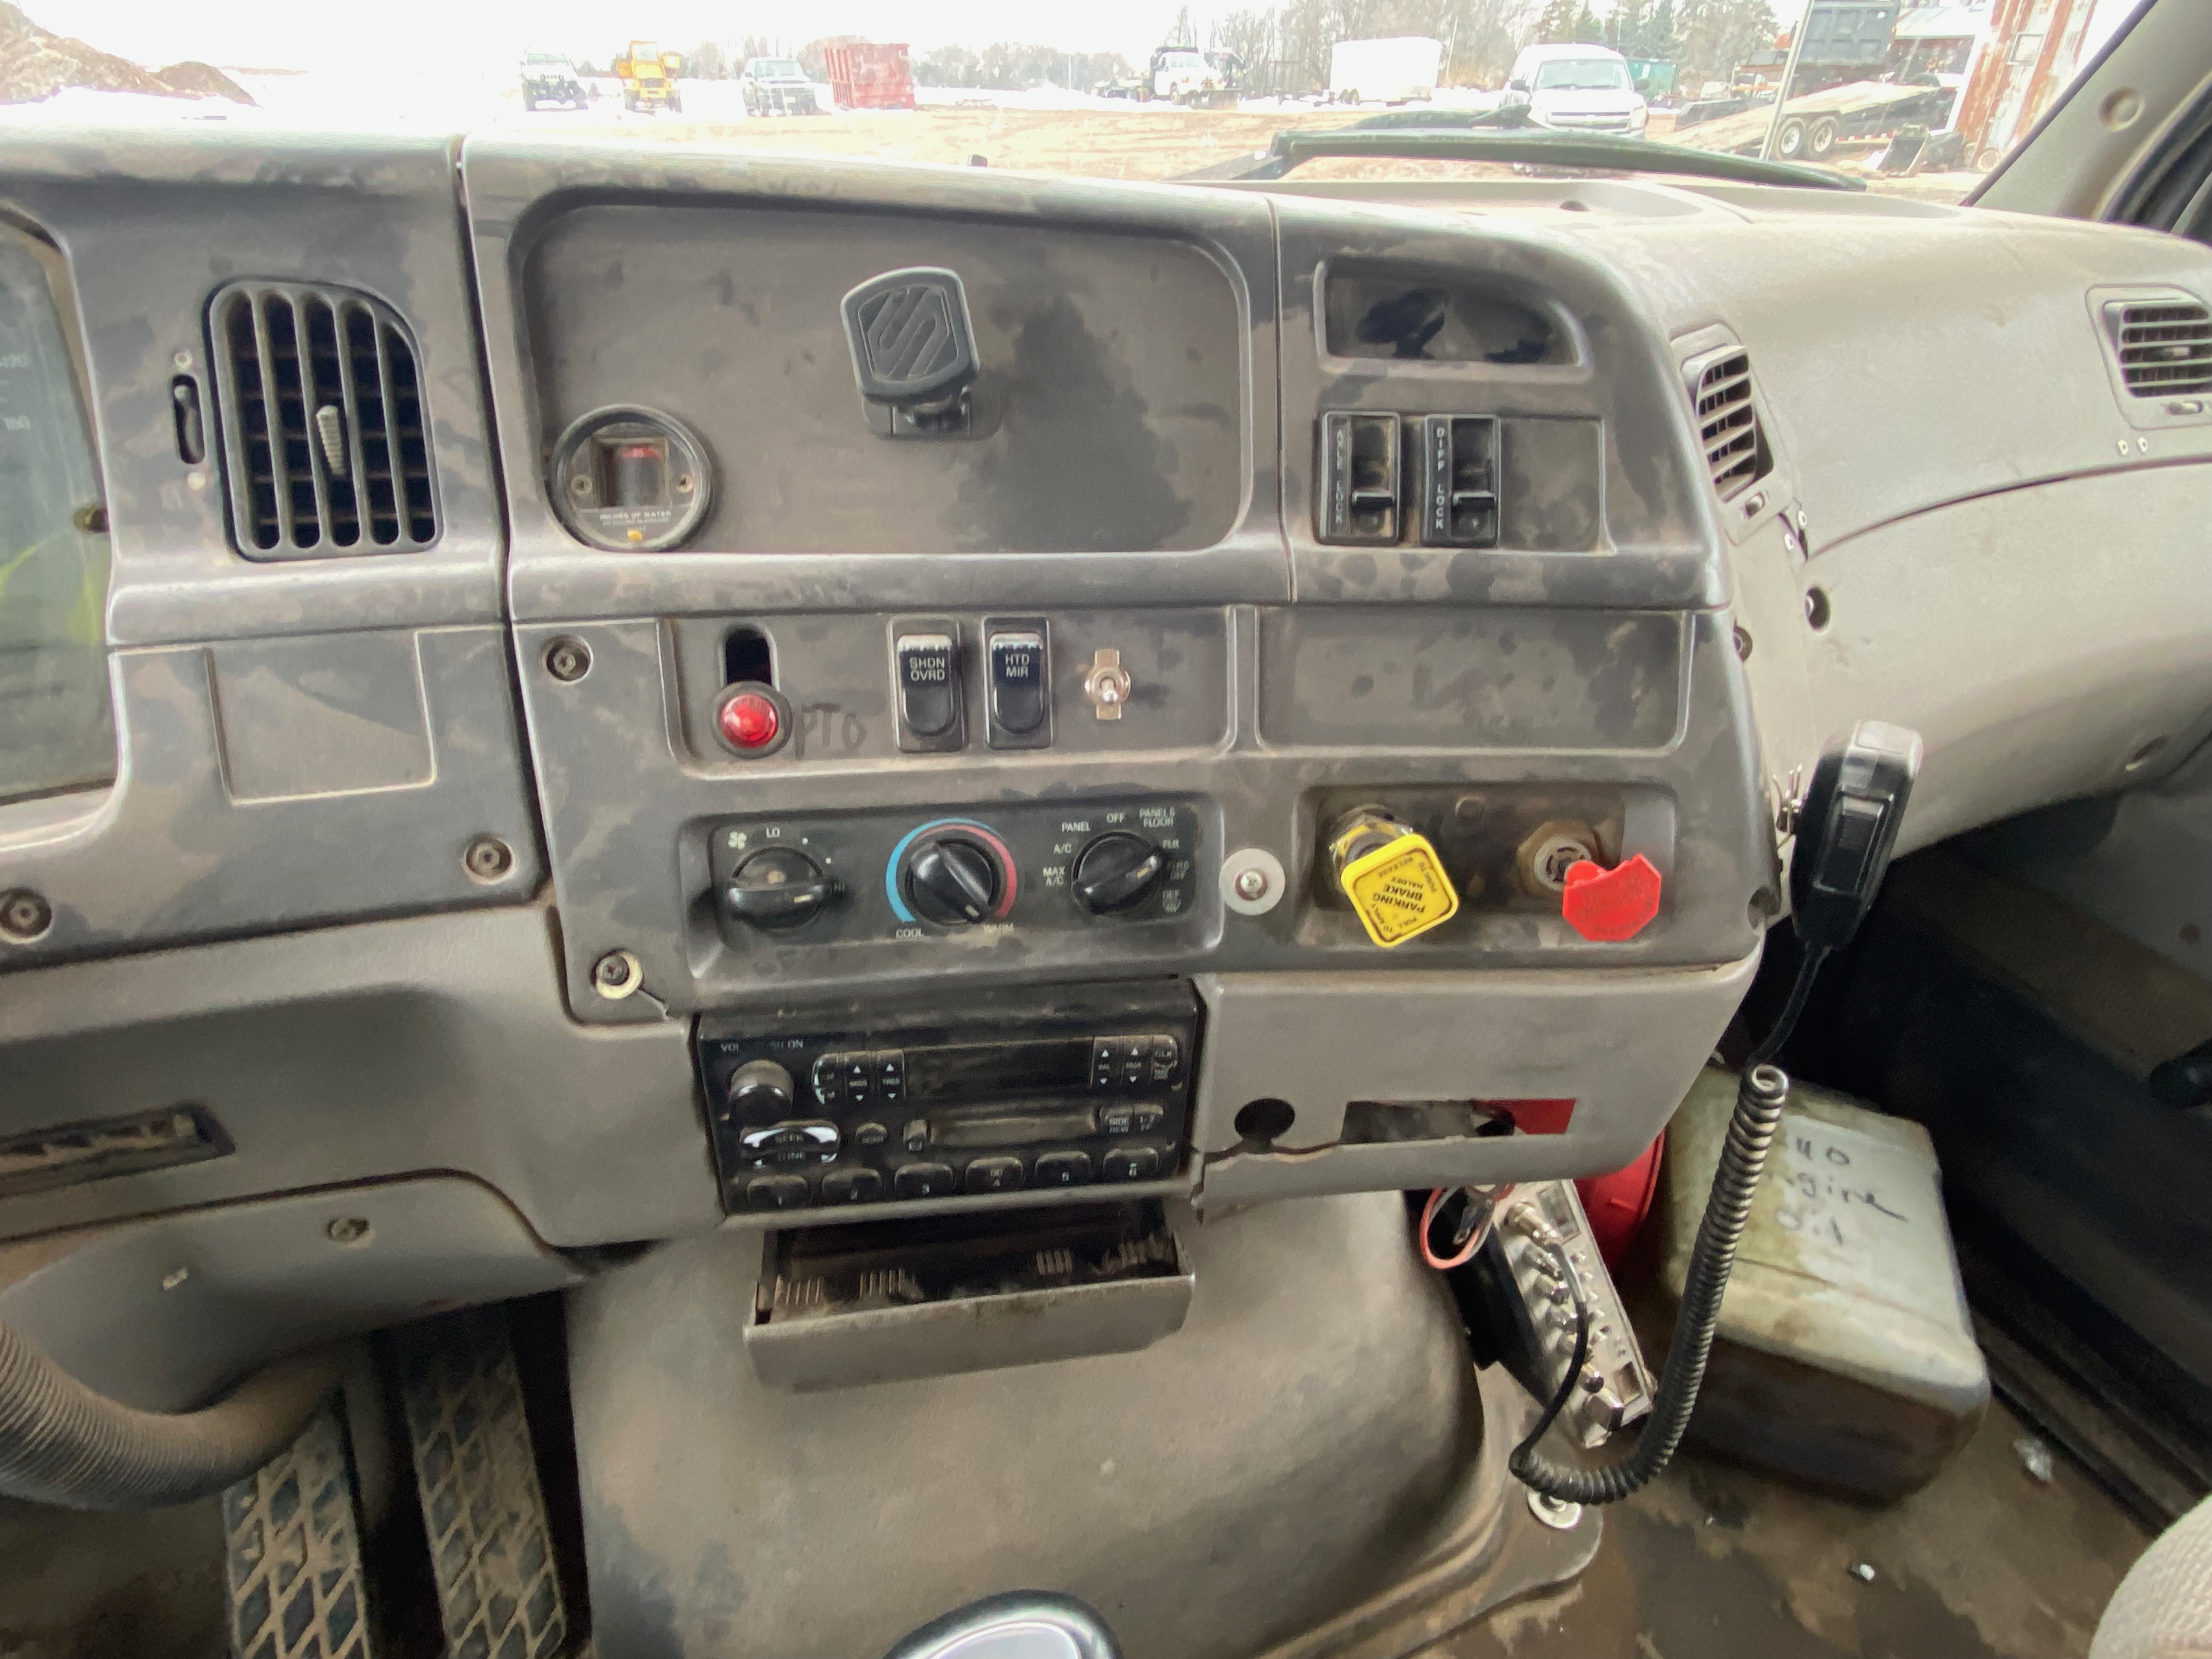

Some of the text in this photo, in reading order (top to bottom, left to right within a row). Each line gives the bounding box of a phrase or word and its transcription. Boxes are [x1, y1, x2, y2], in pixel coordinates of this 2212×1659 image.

[1435, 427, 1446, 530] DIFF LOCK
[644, 510, 672, 518] WATER
[909, 657, 945, 670] SHDN
[1005, 653, 1030, 665] HTD
[910, 669, 945, 682] OVRD
[1006, 665, 1029, 678] MIR
[793, 702, 867, 759] PTO
[1106, 812, 1125, 823] OFF
[1139, 808, 1167, 819] PANEL
[766, 827, 781, 838] LO
[1062, 821, 1091, 833] PANEL
[1053, 842, 1072, 855] A/C
[1043, 866, 1065, 877] MAX
[1045, 876, 1064, 887] A/C
[1391, 876, 1424, 890] HALDEX
[1384, 883, 1423, 901] BRAKE
[1373, 893, 1426, 913] PARKING
[895, 928, 922, 939] COOL
